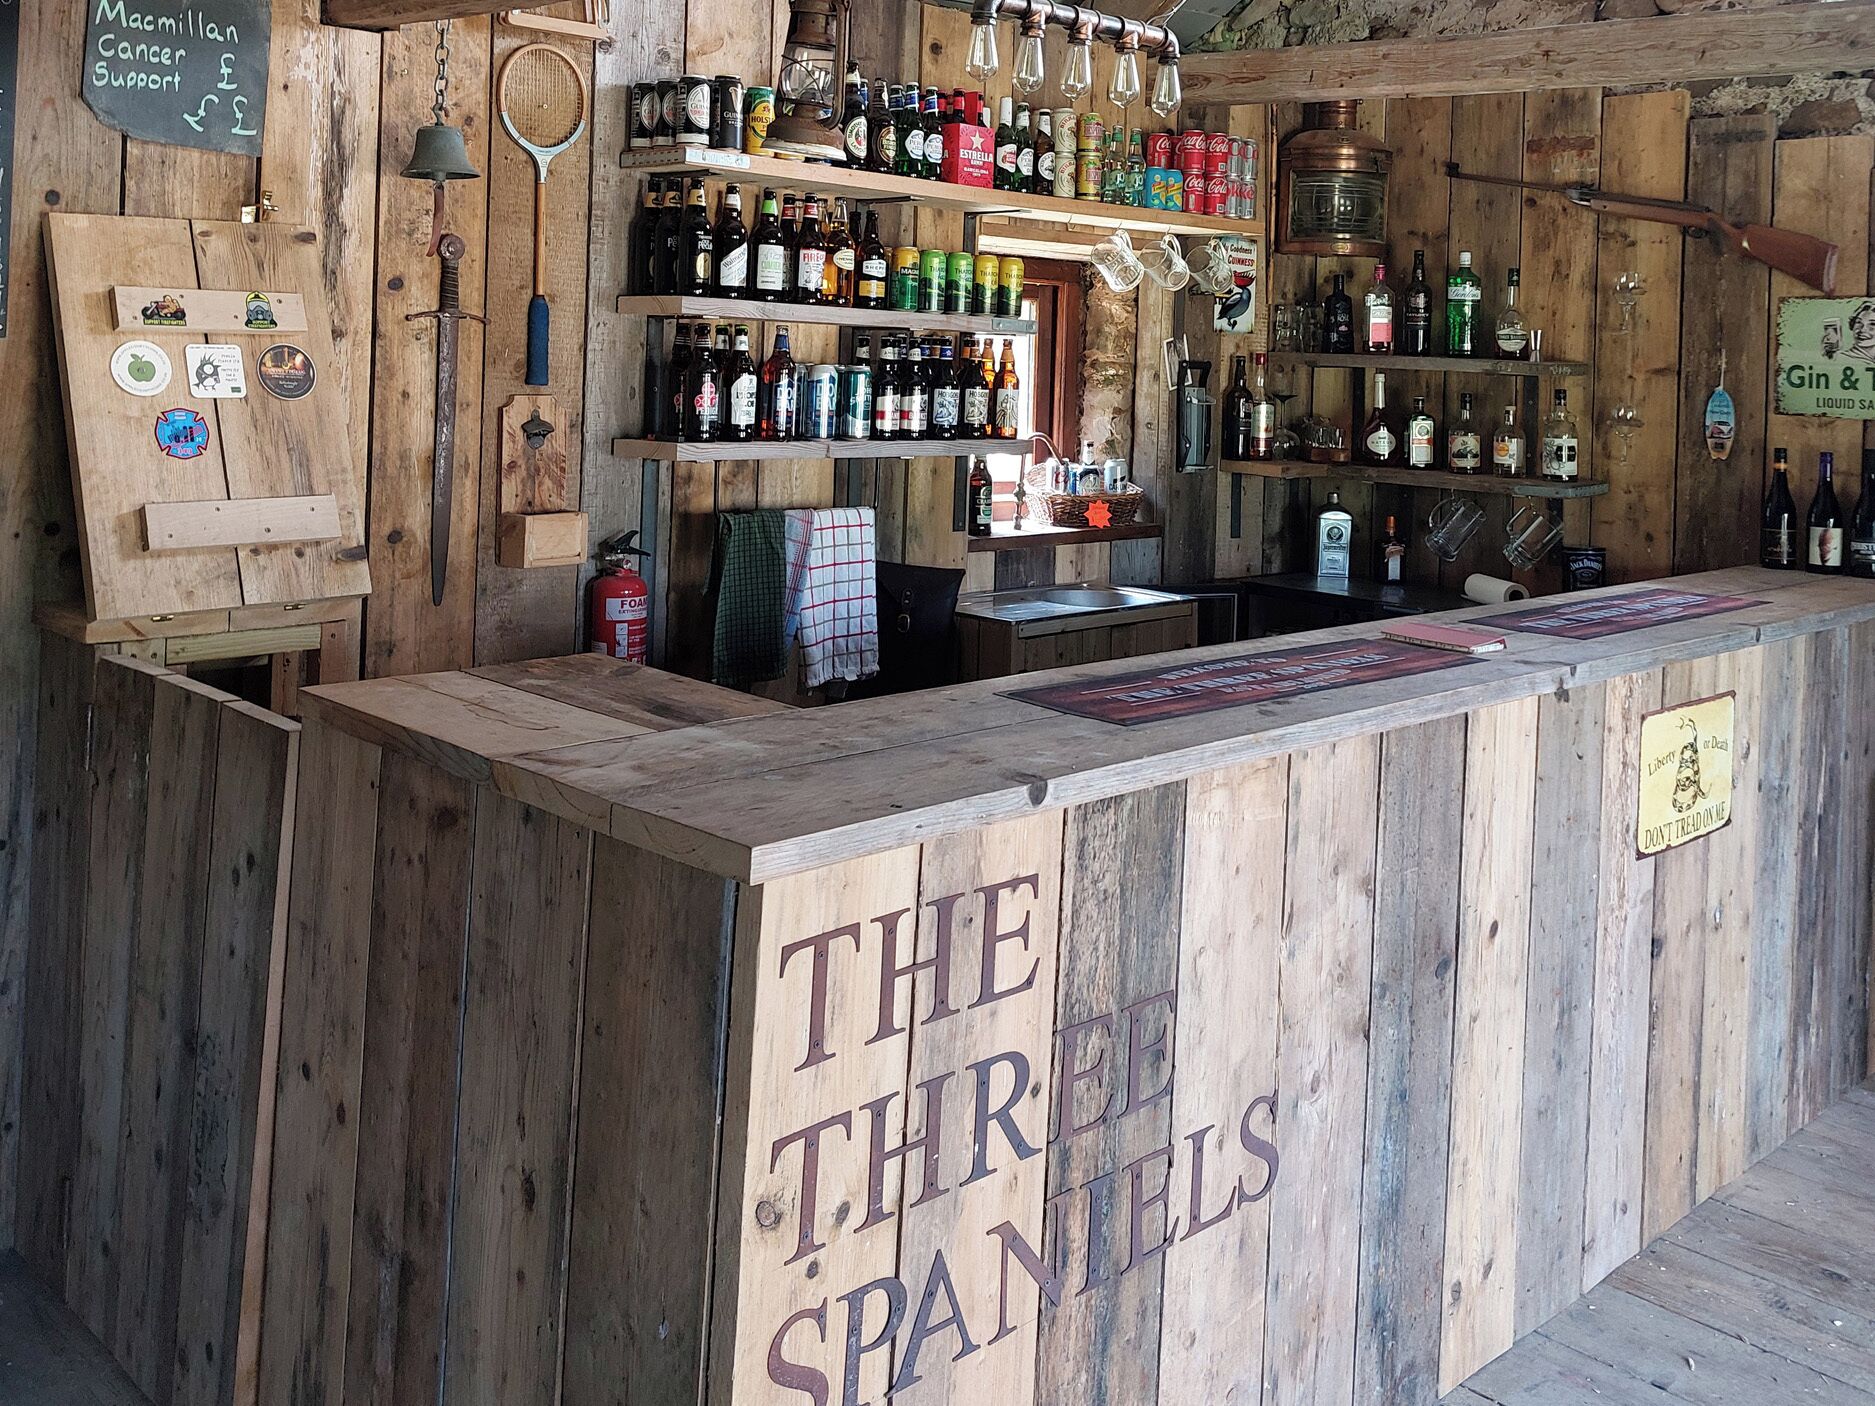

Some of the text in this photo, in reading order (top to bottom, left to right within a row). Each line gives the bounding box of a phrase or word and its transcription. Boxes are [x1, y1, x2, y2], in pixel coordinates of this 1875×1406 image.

[94, 0, 239, 44] Macmillan
[97, 34, 186, 66] Cancer
[92, 61, 182, 92] Support
[216, 53, 238, 91] £
[231, 95, 257, 136] £
[960, 149, 994, 163] ESTRELLA
[1228, 254, 1256, 268] GUINNESS
[1786, 364, 1830, 389] Gin
[1839, 366, 1860, 391] &
[1816, 397, 1855, 410] LIQUID
[1103, 686, 1177, 702] THE
[1173, 671, 1273, 691] THREE
[1156, 659, 1251, 680] WELCOME
[1648, 750, 1676, 777] Liberty
[1711, 735, 1729, 752] Death
[1644, 800, 1727, 850] DON'T TREAD ON ME
[779, 873, 1041, 1073] THE
[769, 989, 1177, 1267] THREE
[767, 1088, 1280, 1406] SPANIELS
